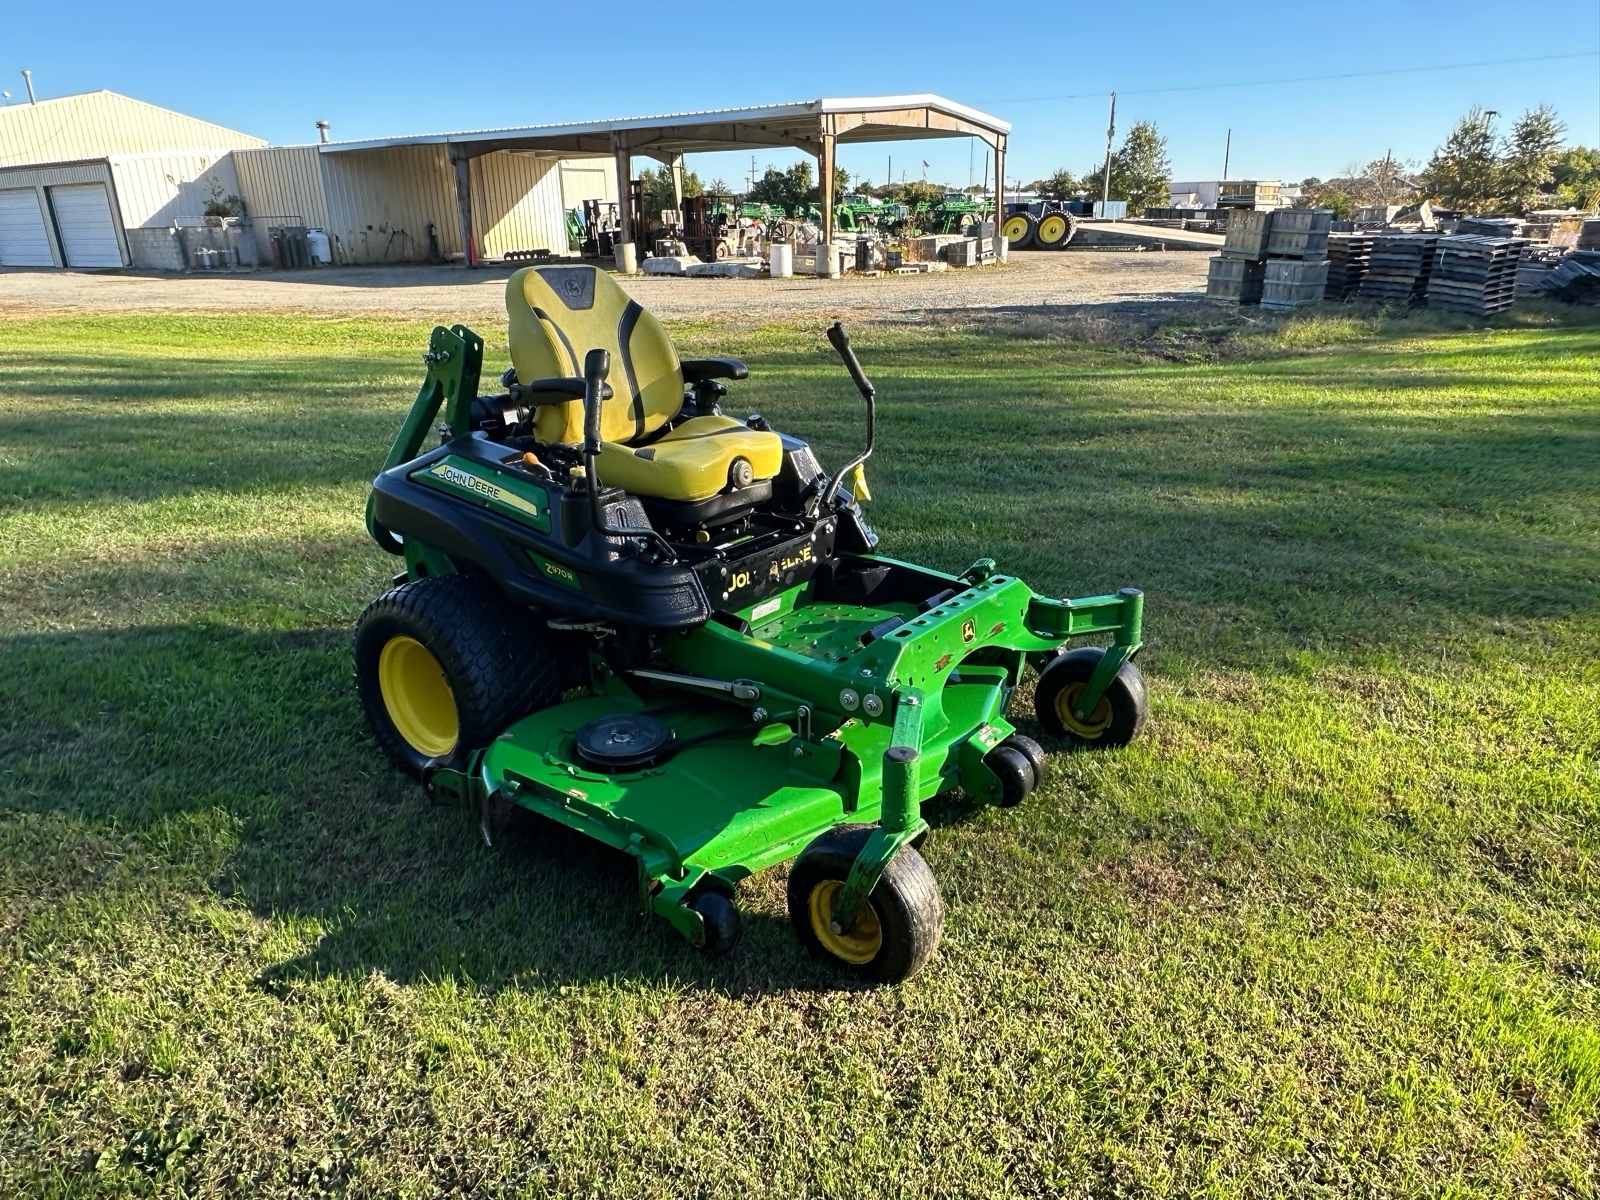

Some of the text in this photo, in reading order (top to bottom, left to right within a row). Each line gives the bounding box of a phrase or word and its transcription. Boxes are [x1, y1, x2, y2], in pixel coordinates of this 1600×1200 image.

[440, 466, 501, 499] JOHN DEERE
[545, 563, 574, 581] Z970R
